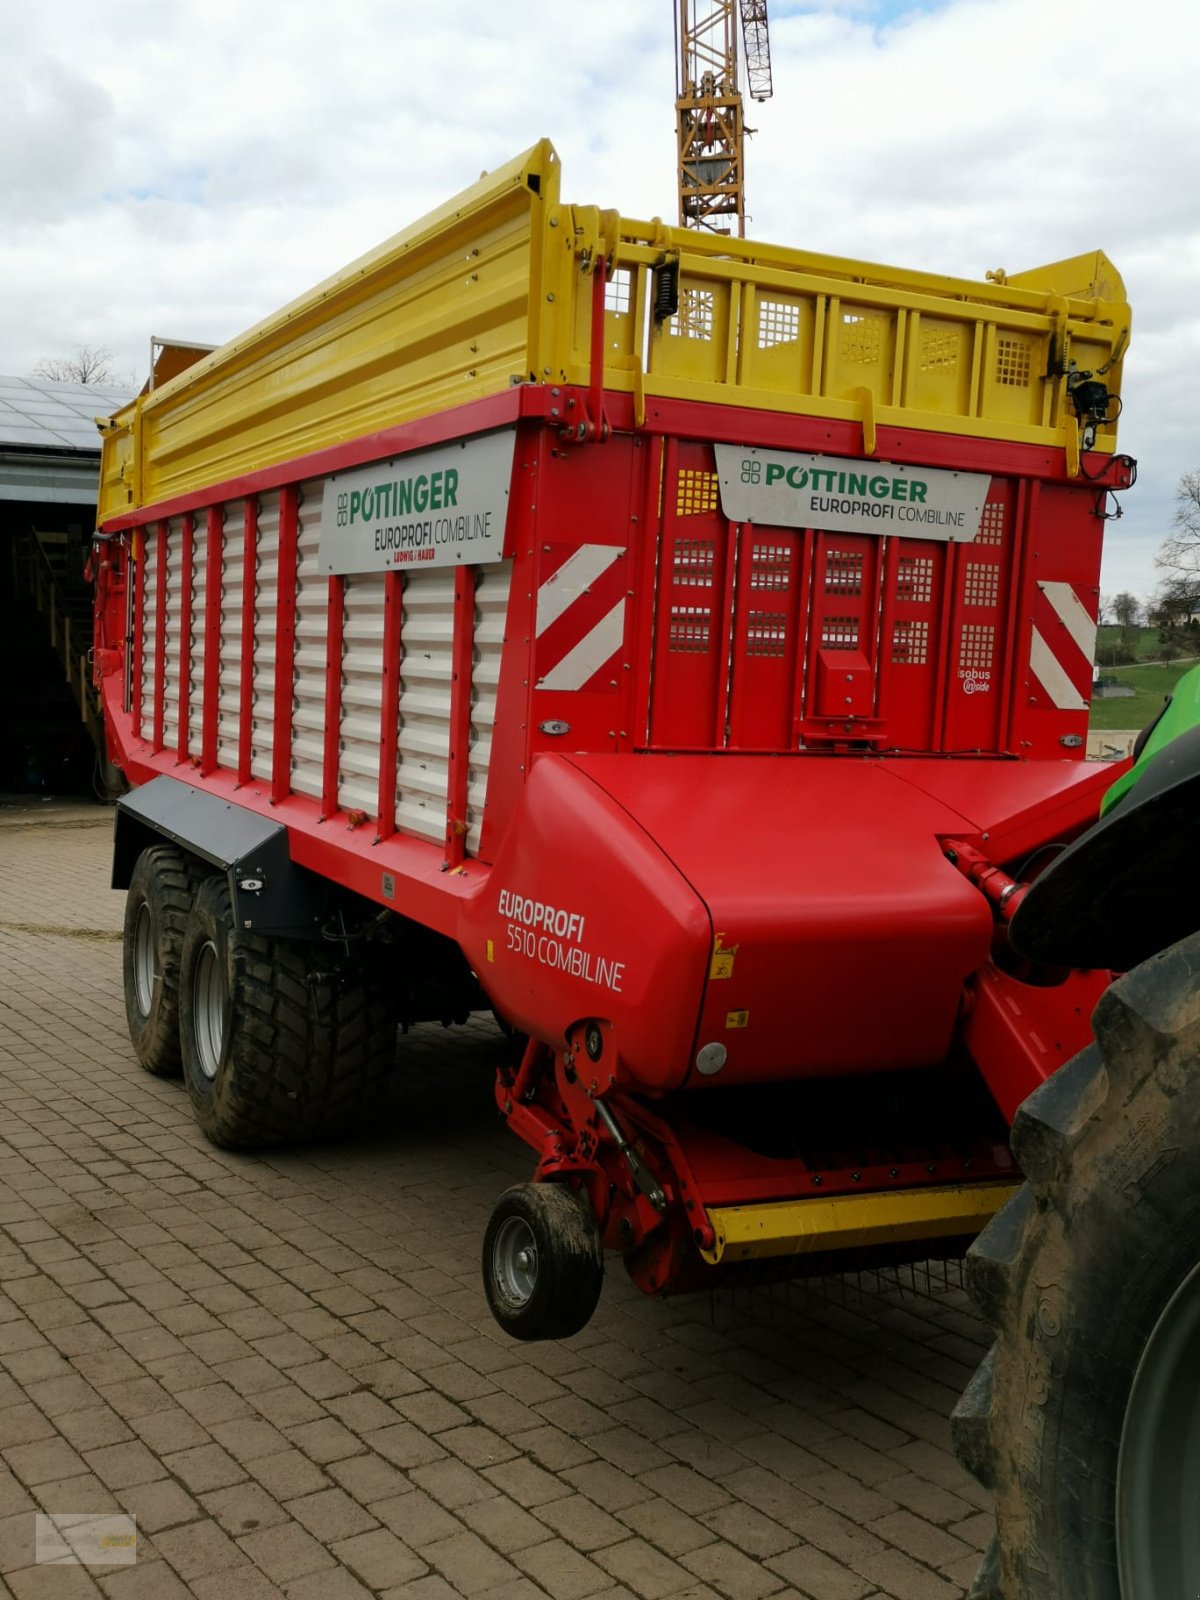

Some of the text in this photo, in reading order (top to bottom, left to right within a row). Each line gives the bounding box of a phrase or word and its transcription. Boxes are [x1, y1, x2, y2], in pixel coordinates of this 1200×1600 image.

[350, 468, 459, 524] PÖTTINGER
[765, 463, 928, 503] PÖTTINGER
[375, 512, 492, 551] EUROPROFI COMBILINE
[810, 496, 965, 527] EUROPROFI COMBILINE
[393, 550, 413, 563] LUDWIG
[498, 889, 585, 943] EUROPROFI
[507, 924, 625, 992] 5510 COMBILINE
